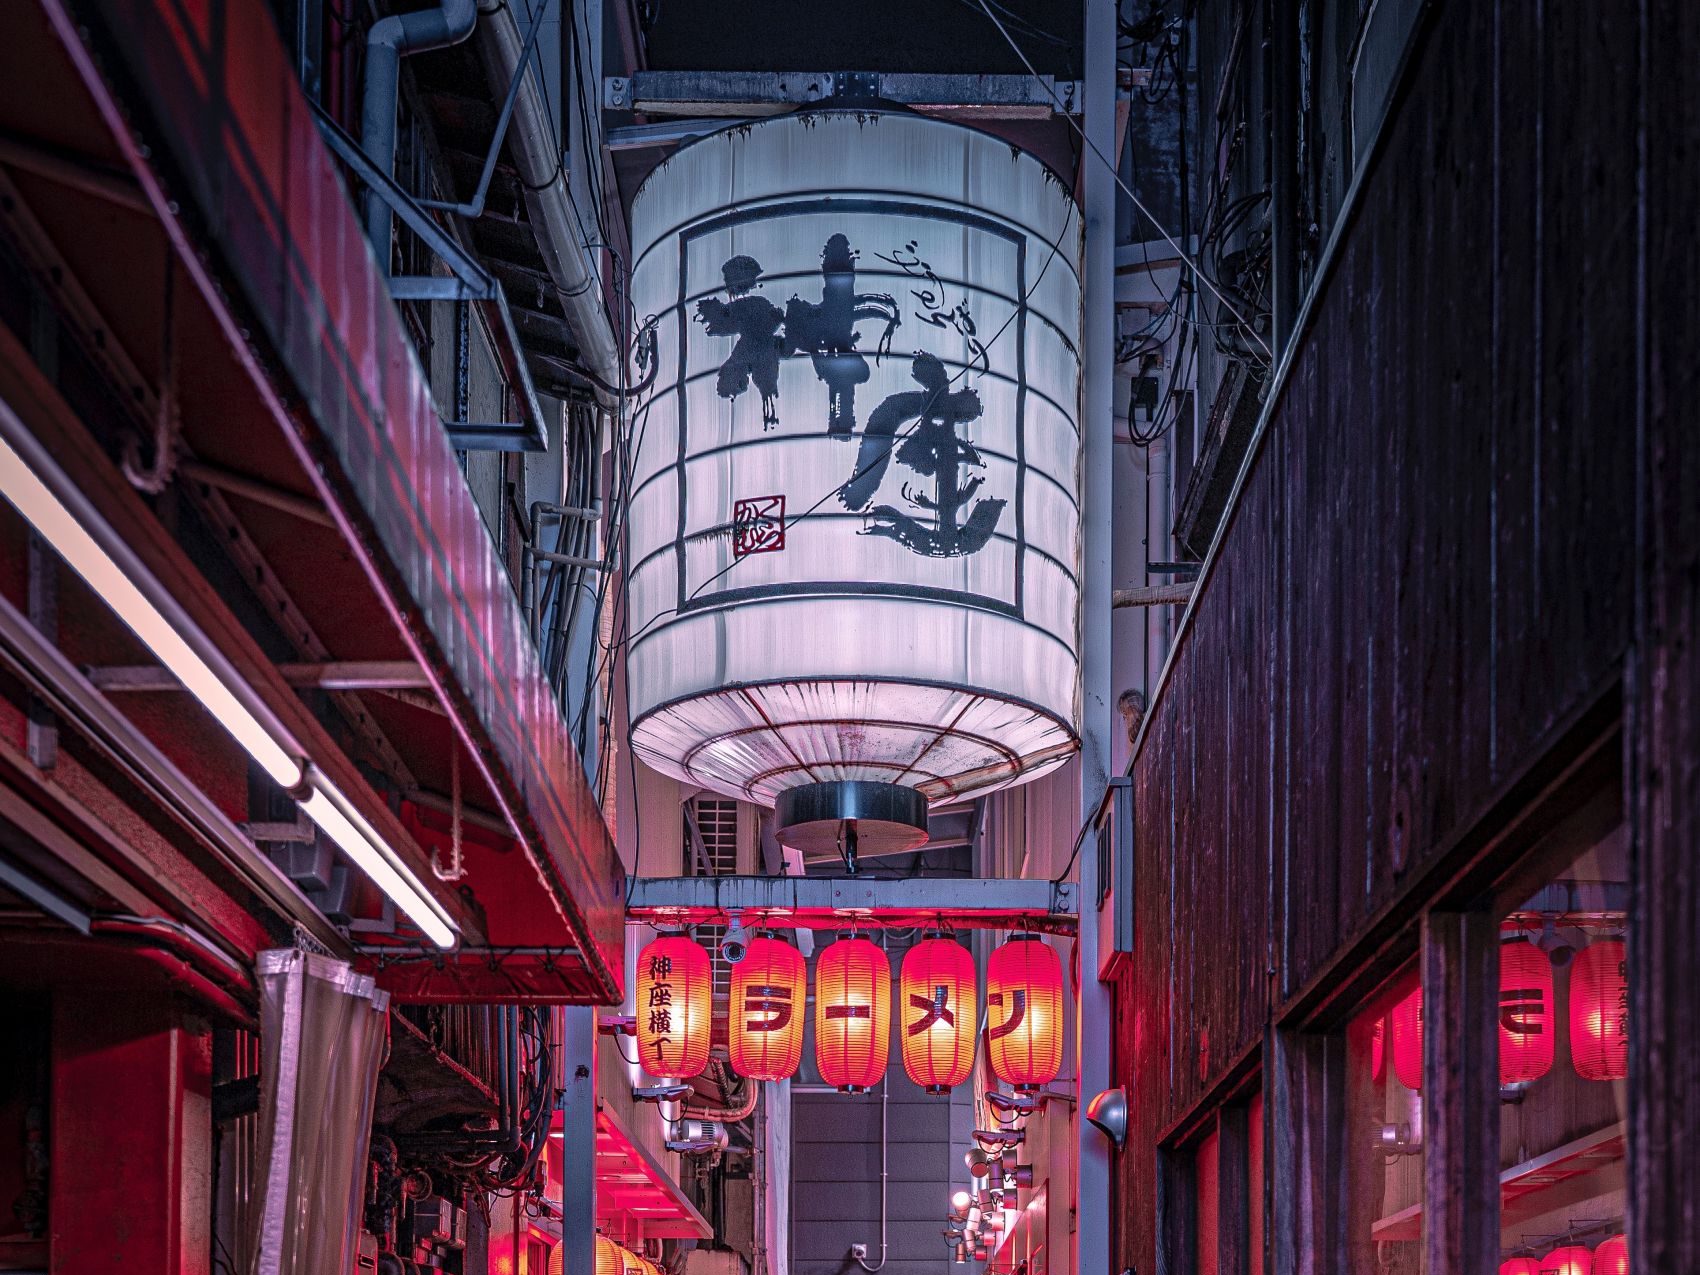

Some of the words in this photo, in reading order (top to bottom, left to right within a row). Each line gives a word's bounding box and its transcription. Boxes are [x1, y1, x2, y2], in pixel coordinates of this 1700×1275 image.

[648, 955, 673, 1060] 神座横丁
[745, 984, 1026, 1041] ラーメン
